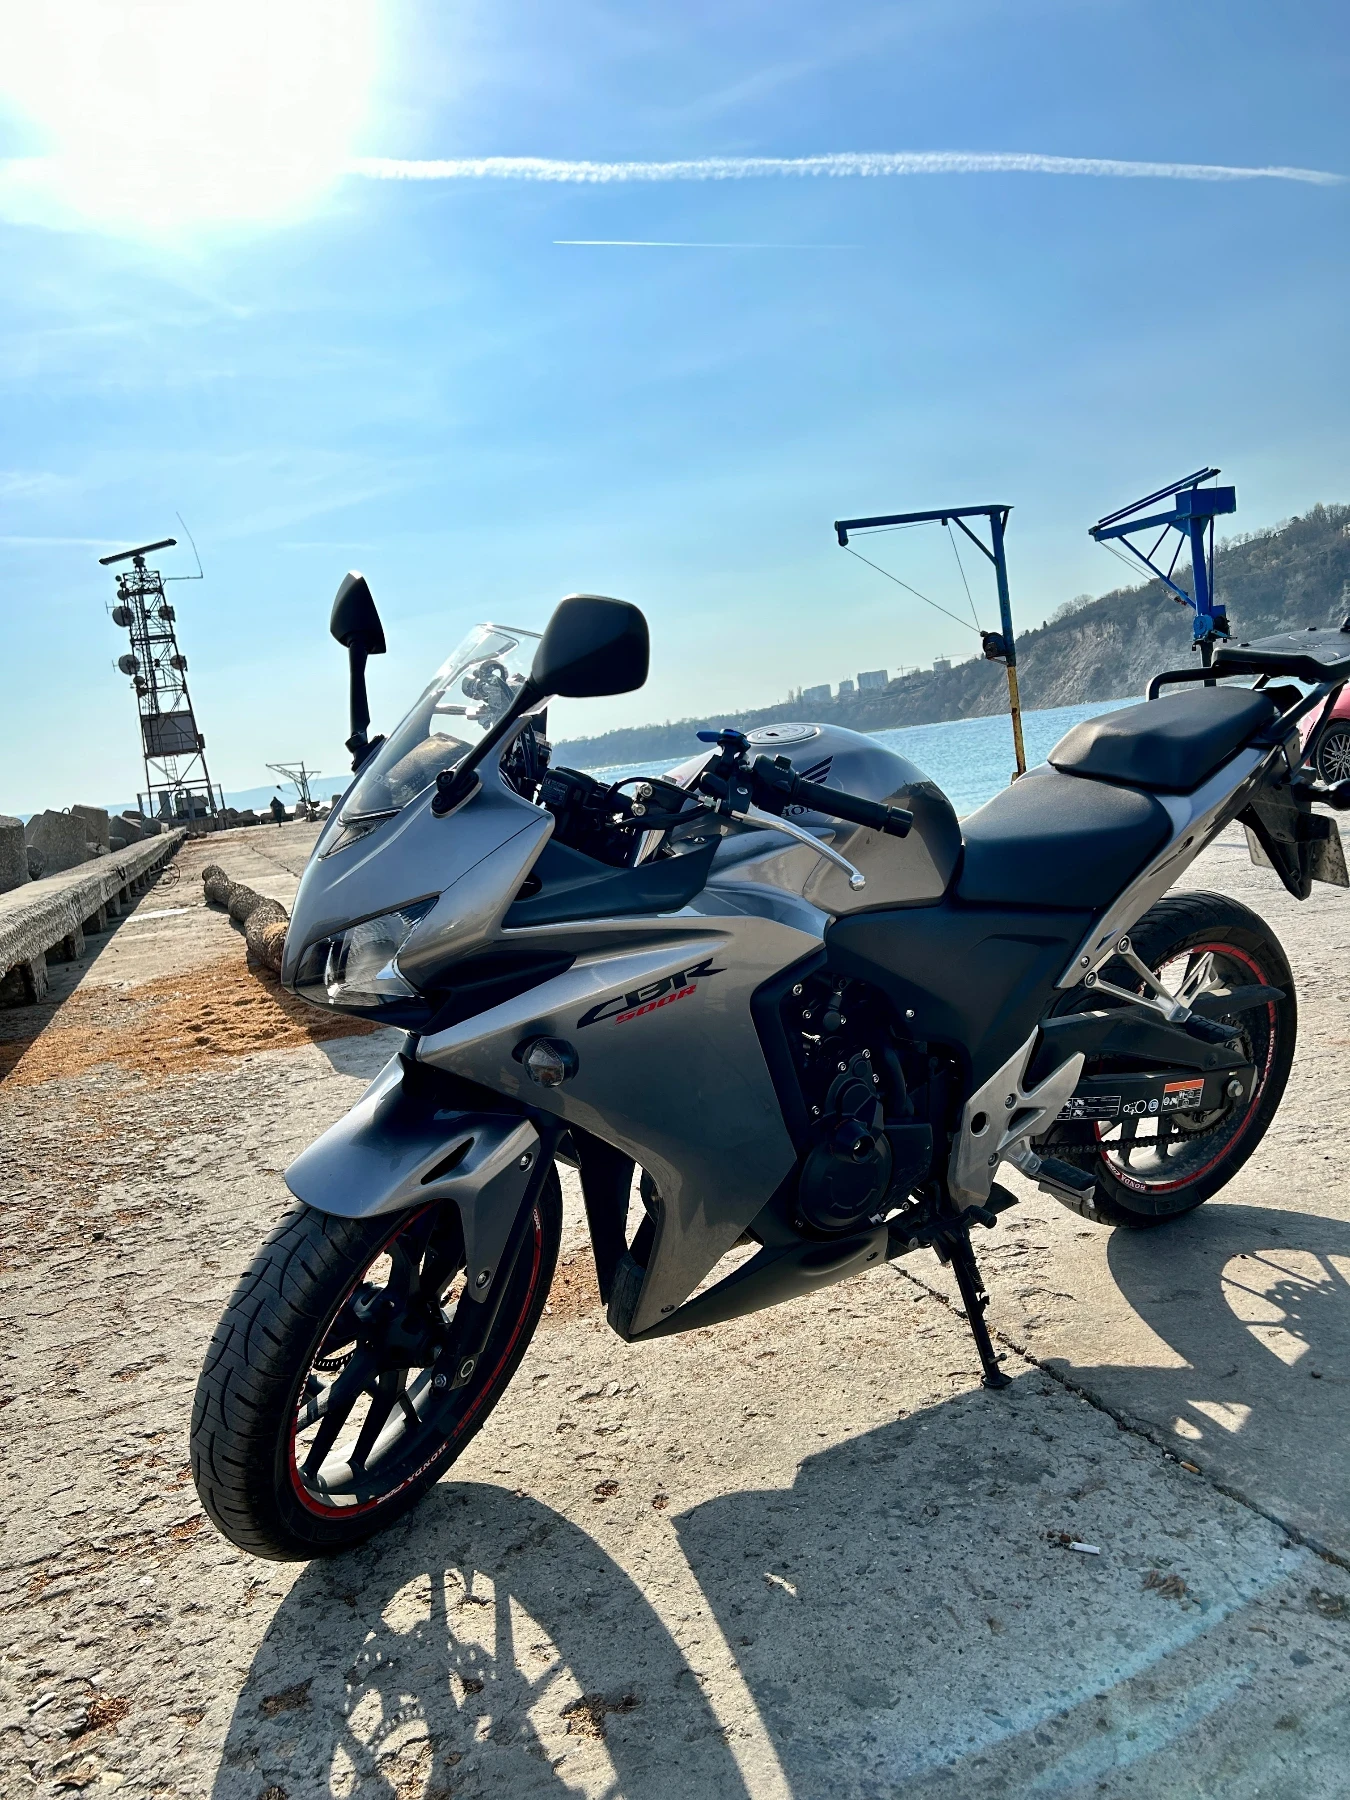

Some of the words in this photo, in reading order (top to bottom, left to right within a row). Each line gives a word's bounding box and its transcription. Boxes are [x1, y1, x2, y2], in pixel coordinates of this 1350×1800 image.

[577, 957, 727, 1029] CBR
[614, 984, 697, 1026] 500R
[1265, 1030, 1275, 1068] HONDA
[1121, 1174, 1146, 1191] HONDA
[407, 1442, 448, 1483] HONDA
